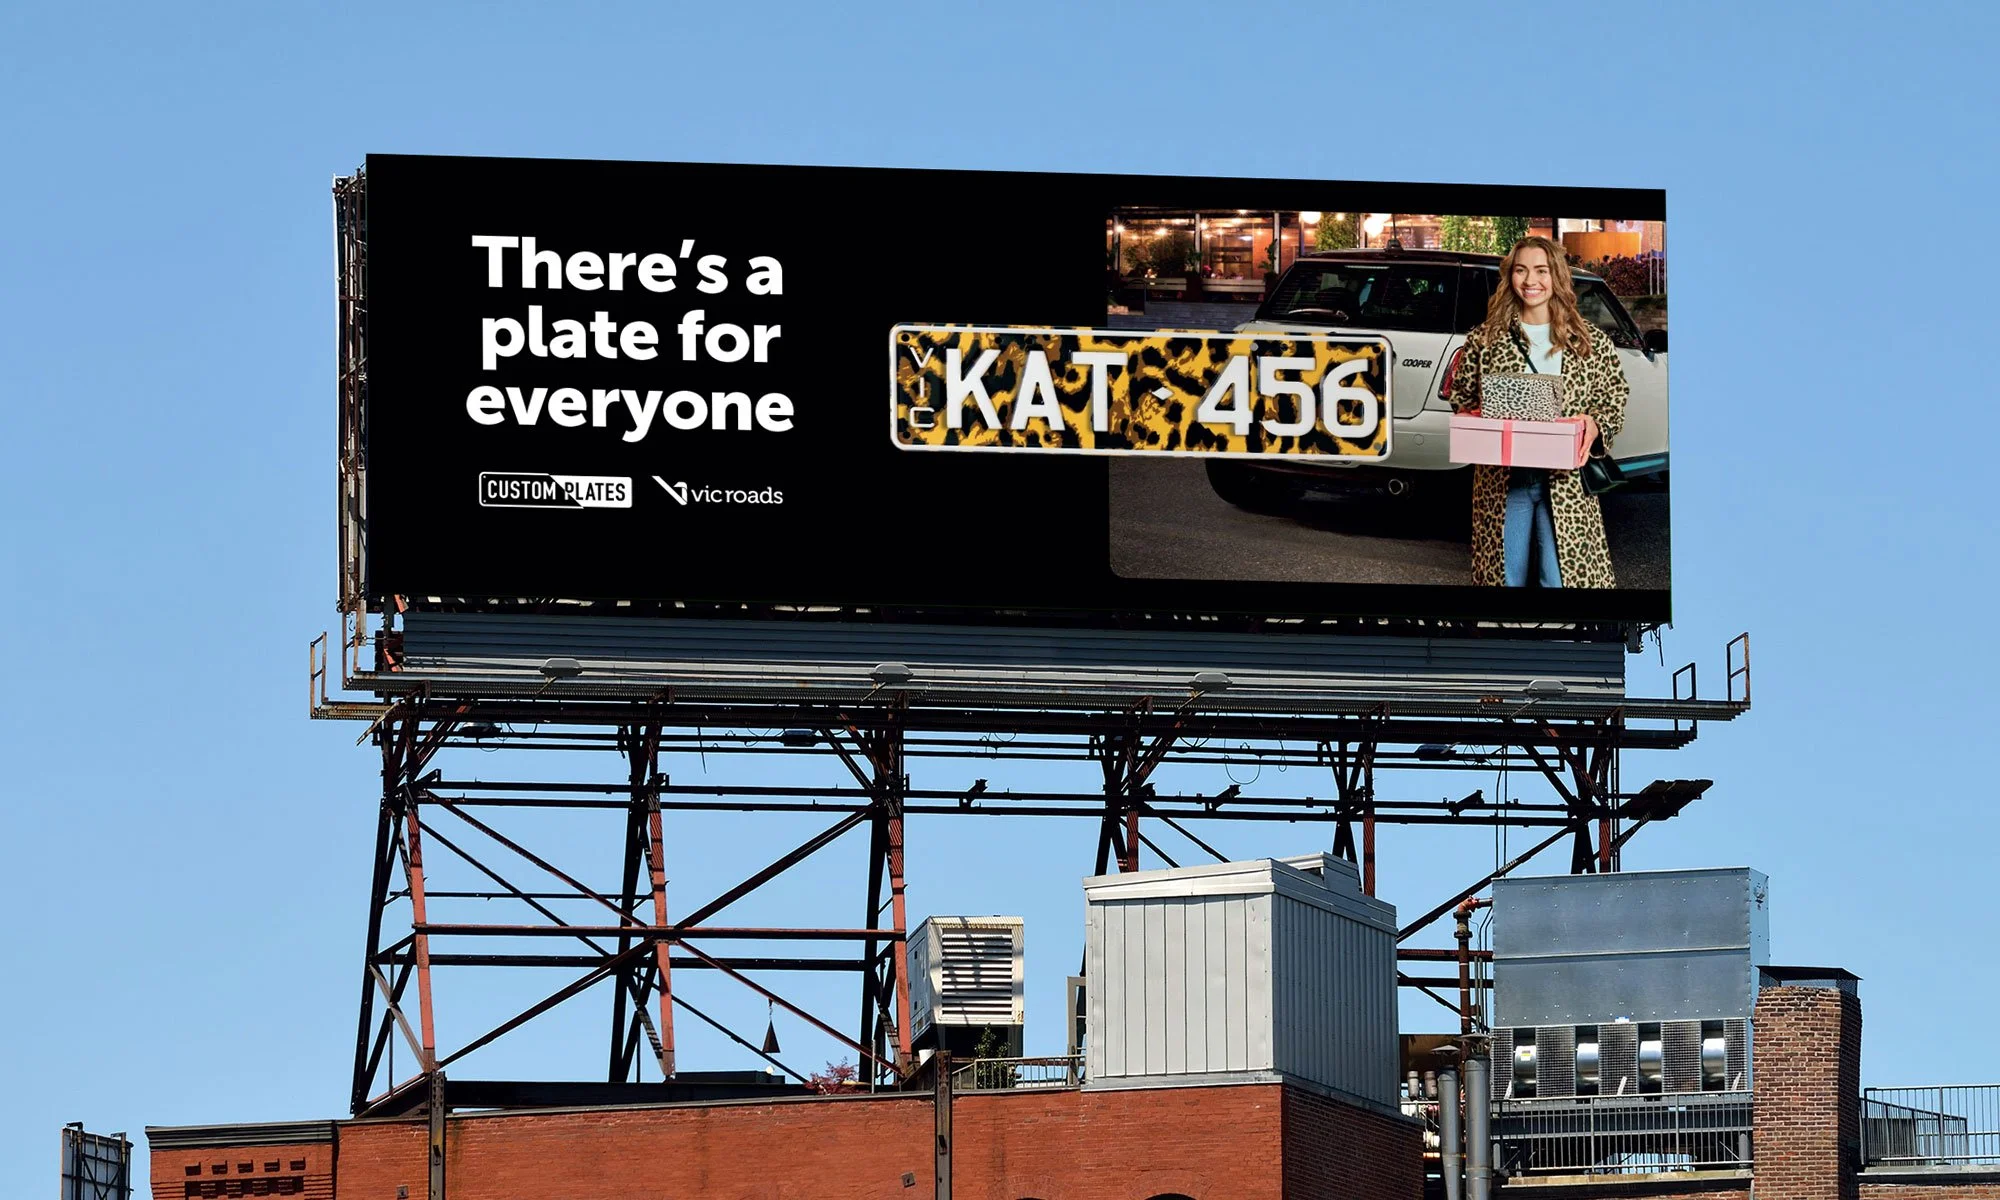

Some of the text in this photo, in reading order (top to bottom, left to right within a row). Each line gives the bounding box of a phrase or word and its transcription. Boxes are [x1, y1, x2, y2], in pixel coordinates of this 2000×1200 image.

[472, 235, 782, 295] There's a
[483, 305, 781, 370] plate for
[1402, 359, 1432, 368] COOPER
[466, 386, 794, 442] everyone
[909, 347, 935, 428] VIC
[946, 348, 1379, 438] KAT 456
[487, 480, 626, 501] CUSTOM PLATES
